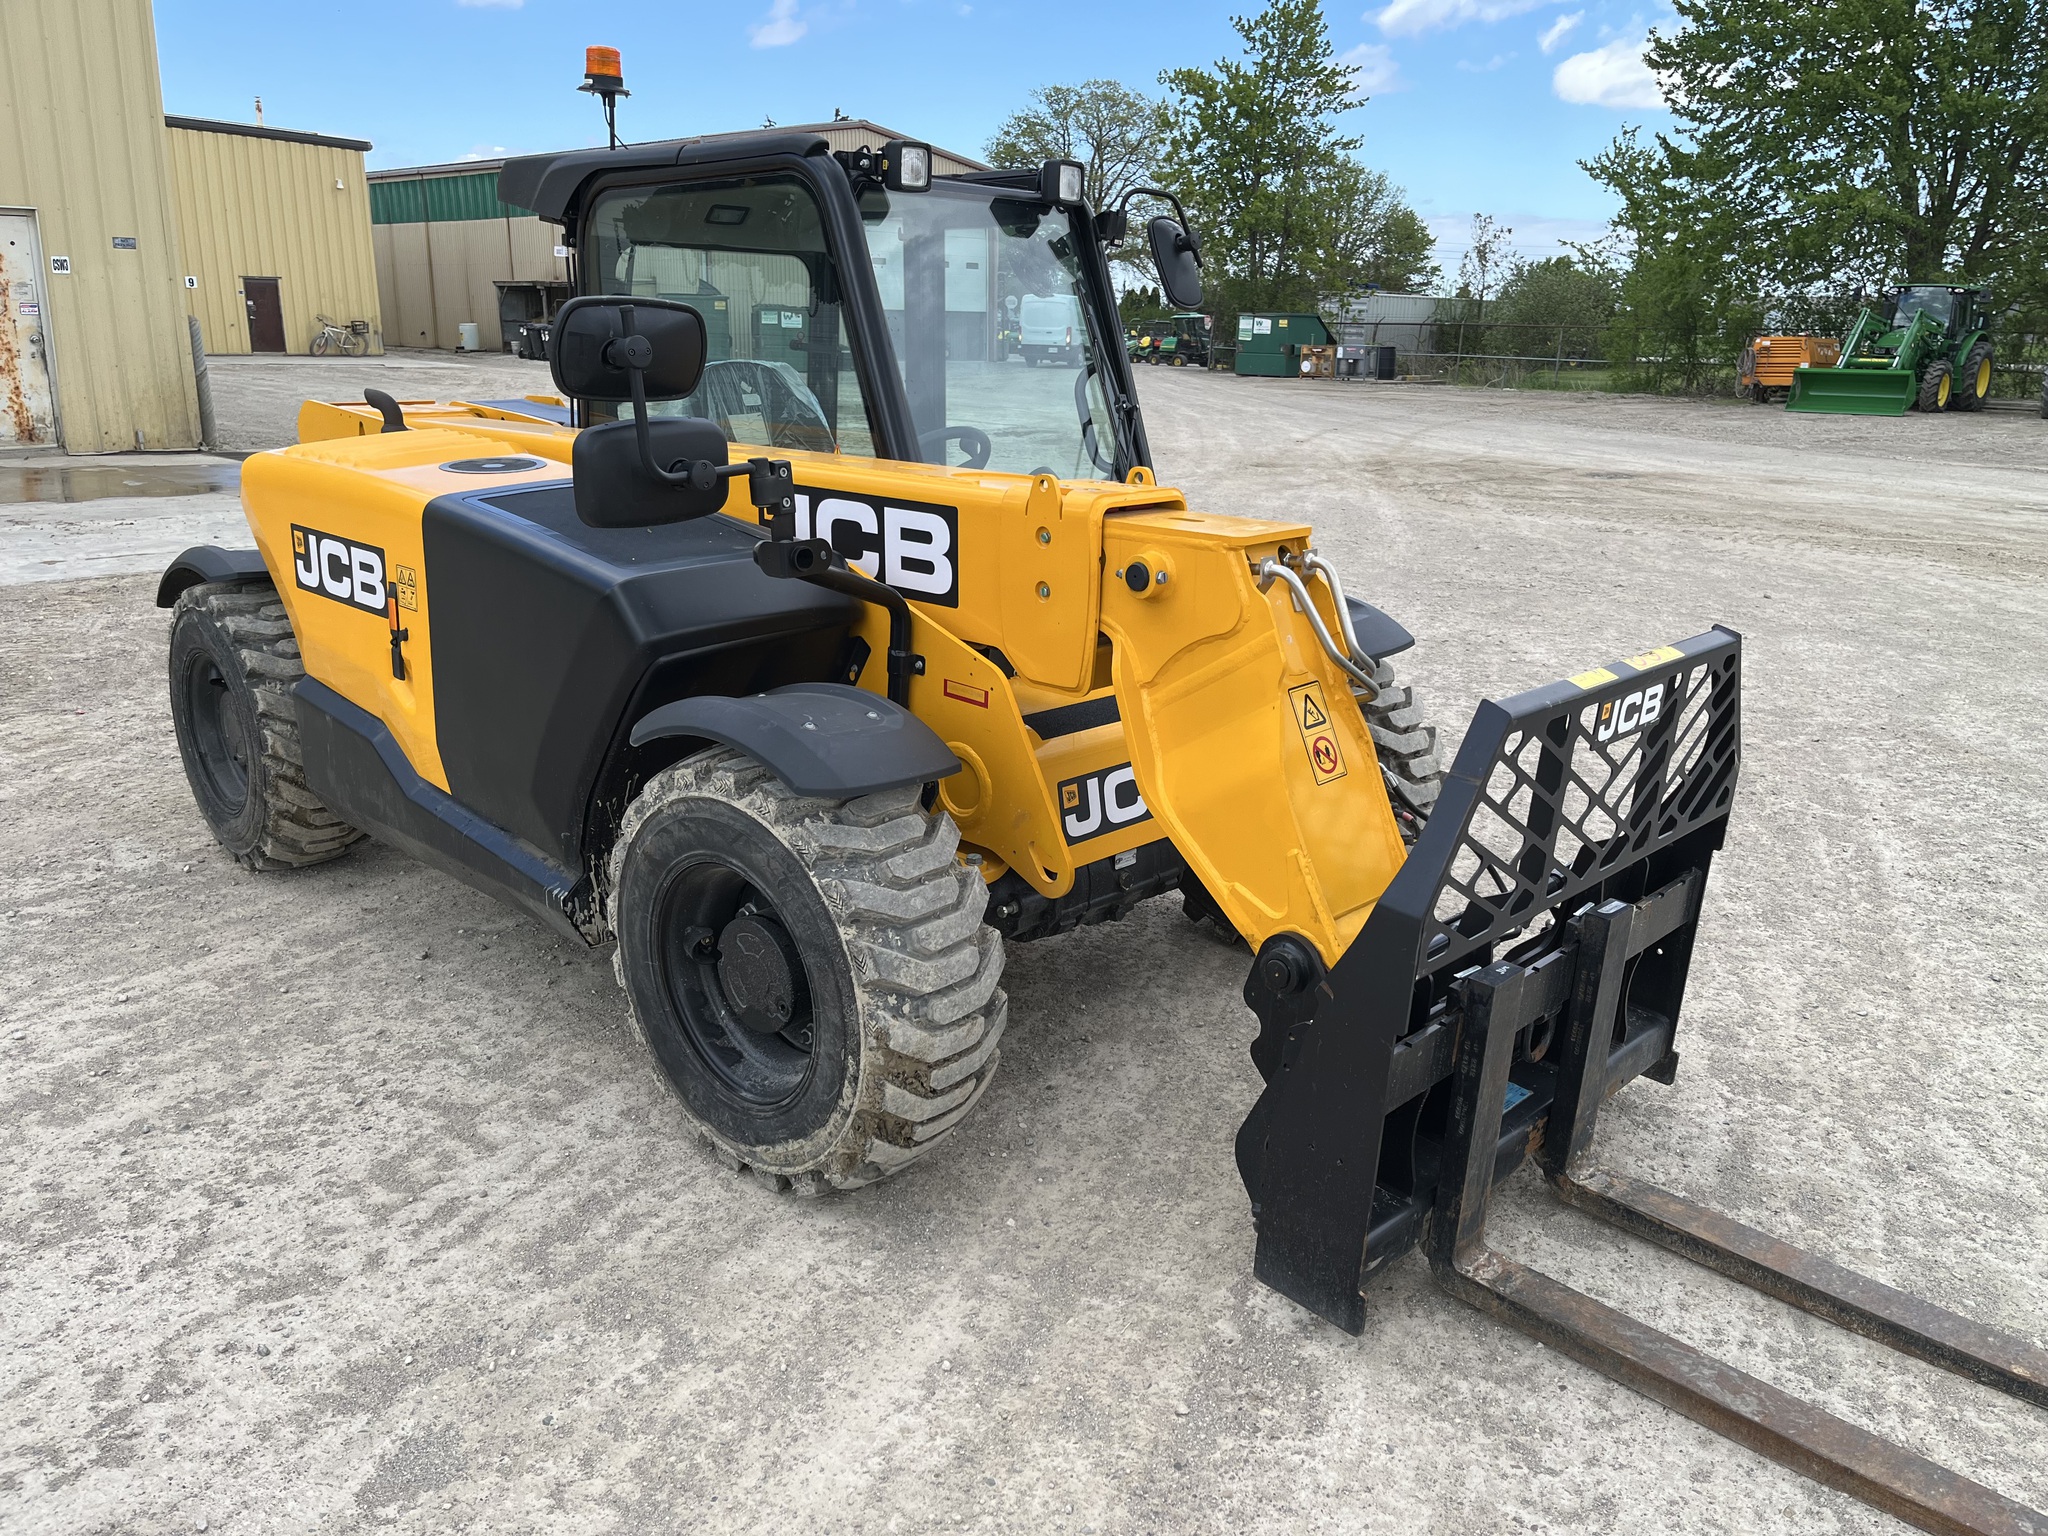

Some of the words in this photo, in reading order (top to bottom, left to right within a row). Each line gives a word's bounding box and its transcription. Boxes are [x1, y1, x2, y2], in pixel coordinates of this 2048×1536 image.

[188, 278, 195, 287] 9
[296, 534, 386, 610] JCB
[1598, 683, 1664, 742] JCB
[1065, 766, 1148, 837] JC
